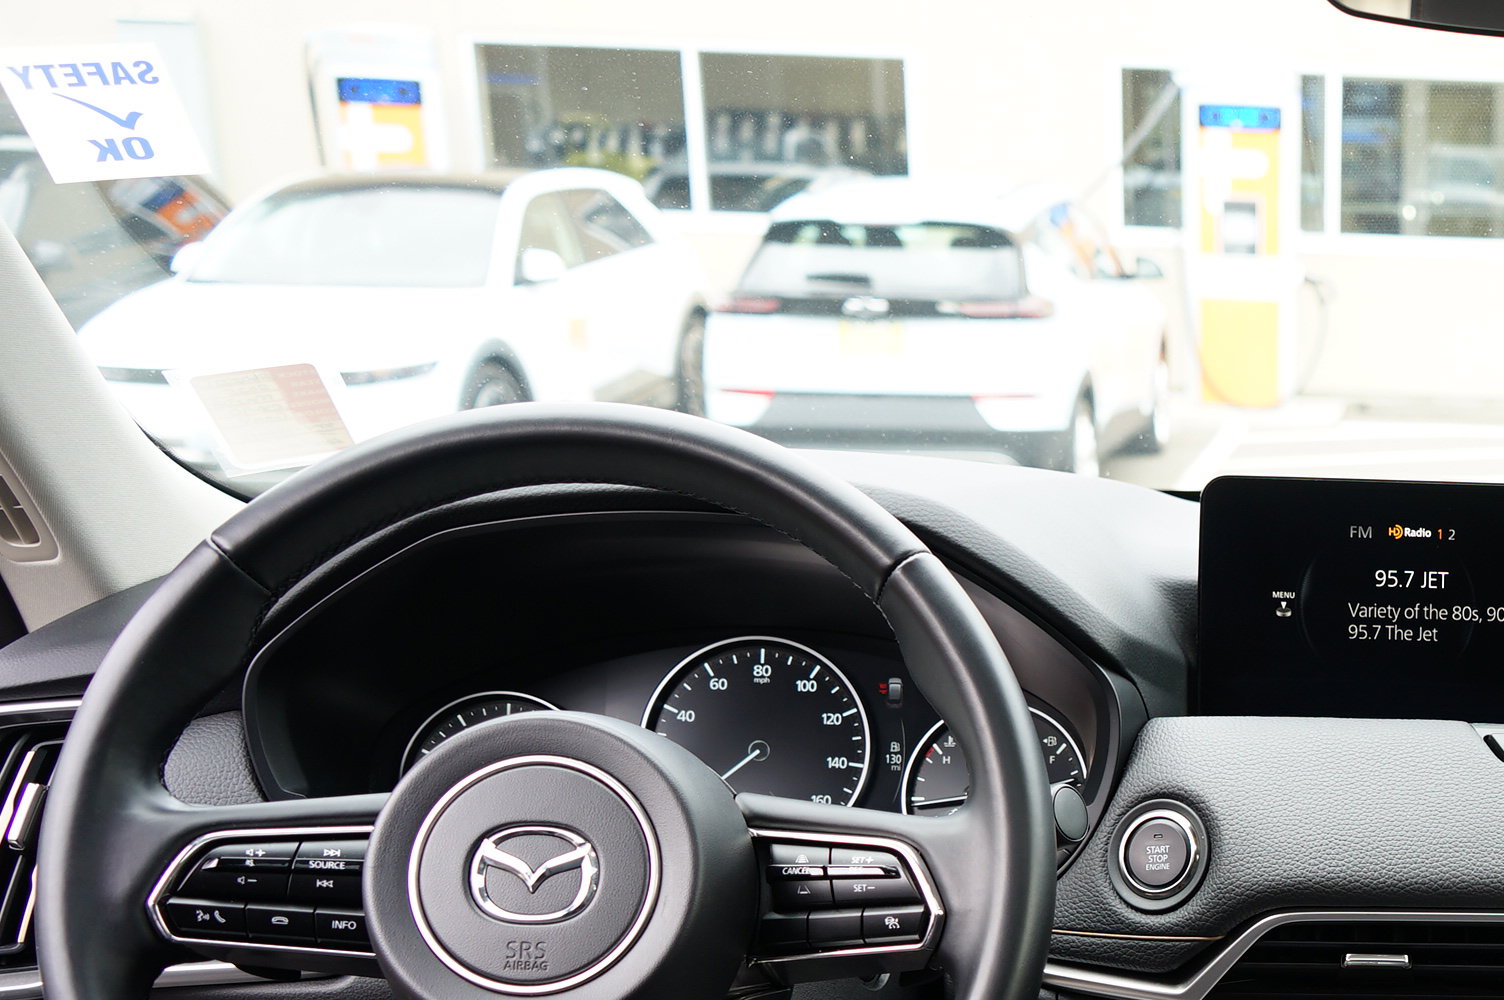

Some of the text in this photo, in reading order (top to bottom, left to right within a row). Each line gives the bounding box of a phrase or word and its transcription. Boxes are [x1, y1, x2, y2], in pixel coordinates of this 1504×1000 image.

[1350, 525, 1373, 539] FM
[1404, 527, 1432, 538] Radio
[1448, 529, 1456, 541] 2
[1374, 569, 1450, 589] 95.7 JET
[1272, 591, 1296, 599] MENU
[1348, 602, 1401, 623] Variety
[1404, 603, 1421, 619] of
[1423, 604, 1448, 621] the
[1452, 606, 1483, 623] 80s,
[1348, 624, 1438, 642] 95.7 The Jet
[753, 665, 772, 677] 80
[709, 678, 728, 690] 60
[796, 680, 817, 692] 100
[676, 710, 695, 722] 40
[822, 713, 842, 725] 120
[826, 757, 847, 769] 140
[886, 754, 902, 765] 130
[942, 756, 951, 764] H
[1049, 756, 1056, 764] F
[1146, 845, 1170, 854] START
[1148, 854, 1169, 863] STOP
[309, 860, 346, 870] SOURCE
[1145, 863, 1170, 871] ENGINE
[331, 920, 357, 930] INFO
[505, 940, 548, 960] SRS
[503, 960, 550, 971] AIRBAG
